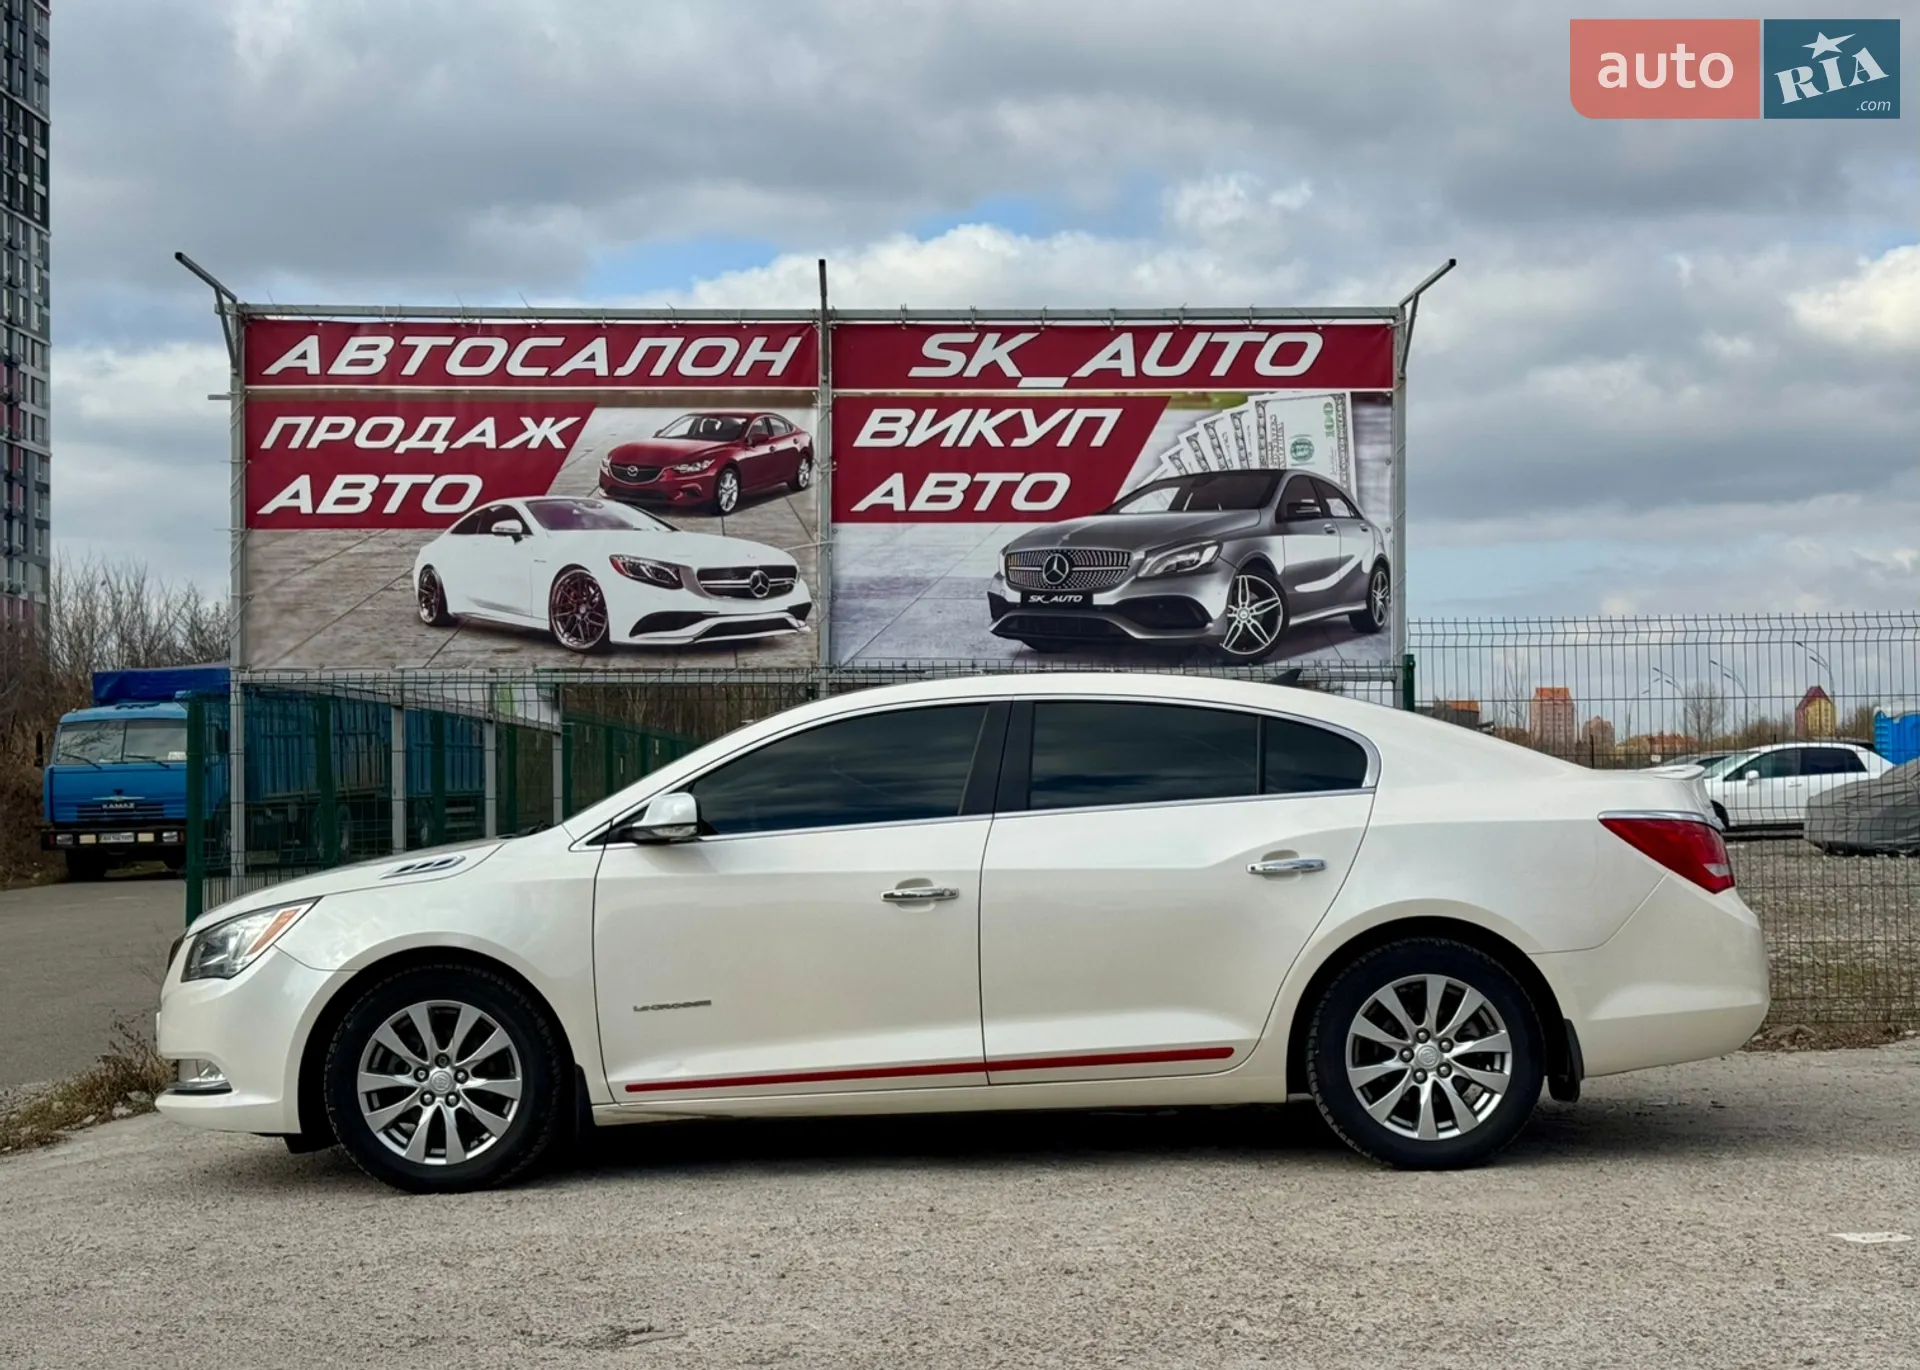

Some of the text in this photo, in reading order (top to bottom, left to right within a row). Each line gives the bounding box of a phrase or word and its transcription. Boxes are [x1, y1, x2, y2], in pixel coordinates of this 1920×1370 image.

[262, 334, 802, 377] АВТОСАЛОН
[907, 331, 1325, 389] SK_AUTO
[260, 415, 580, 454] ПРОДАЖ
[852, 408, 1124, 448] ВИКУП
[256, 474, 484, 515] АВТО
[850, 472, 1071, 512] АВТО
[1028, 594, 1083, 604] SK_AUTO
